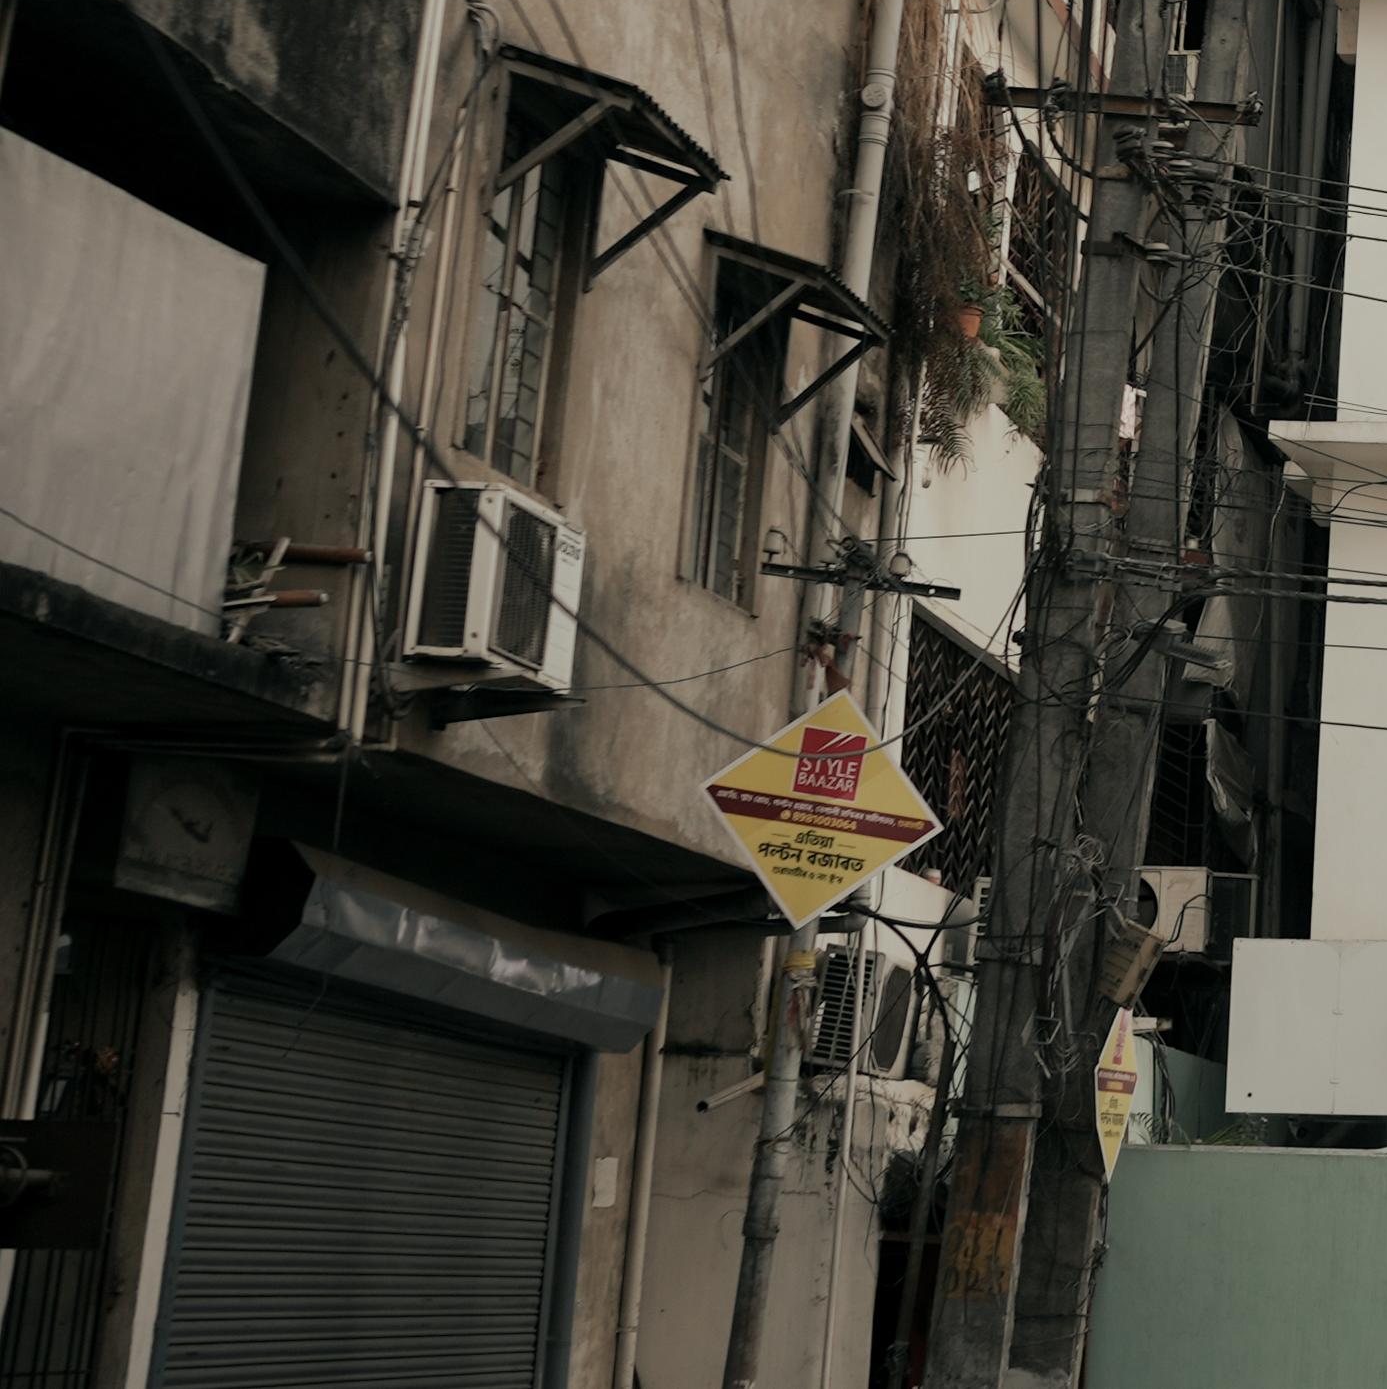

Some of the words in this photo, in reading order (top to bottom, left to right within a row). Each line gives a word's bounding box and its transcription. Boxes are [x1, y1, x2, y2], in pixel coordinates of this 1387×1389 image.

[800, 756, 859, 779] STYLE
[797, 773, 856, 793] BAAZAR
[757, 841, 801, 864] পল্টন
[807, 850, 867, 872] বজাৰত
